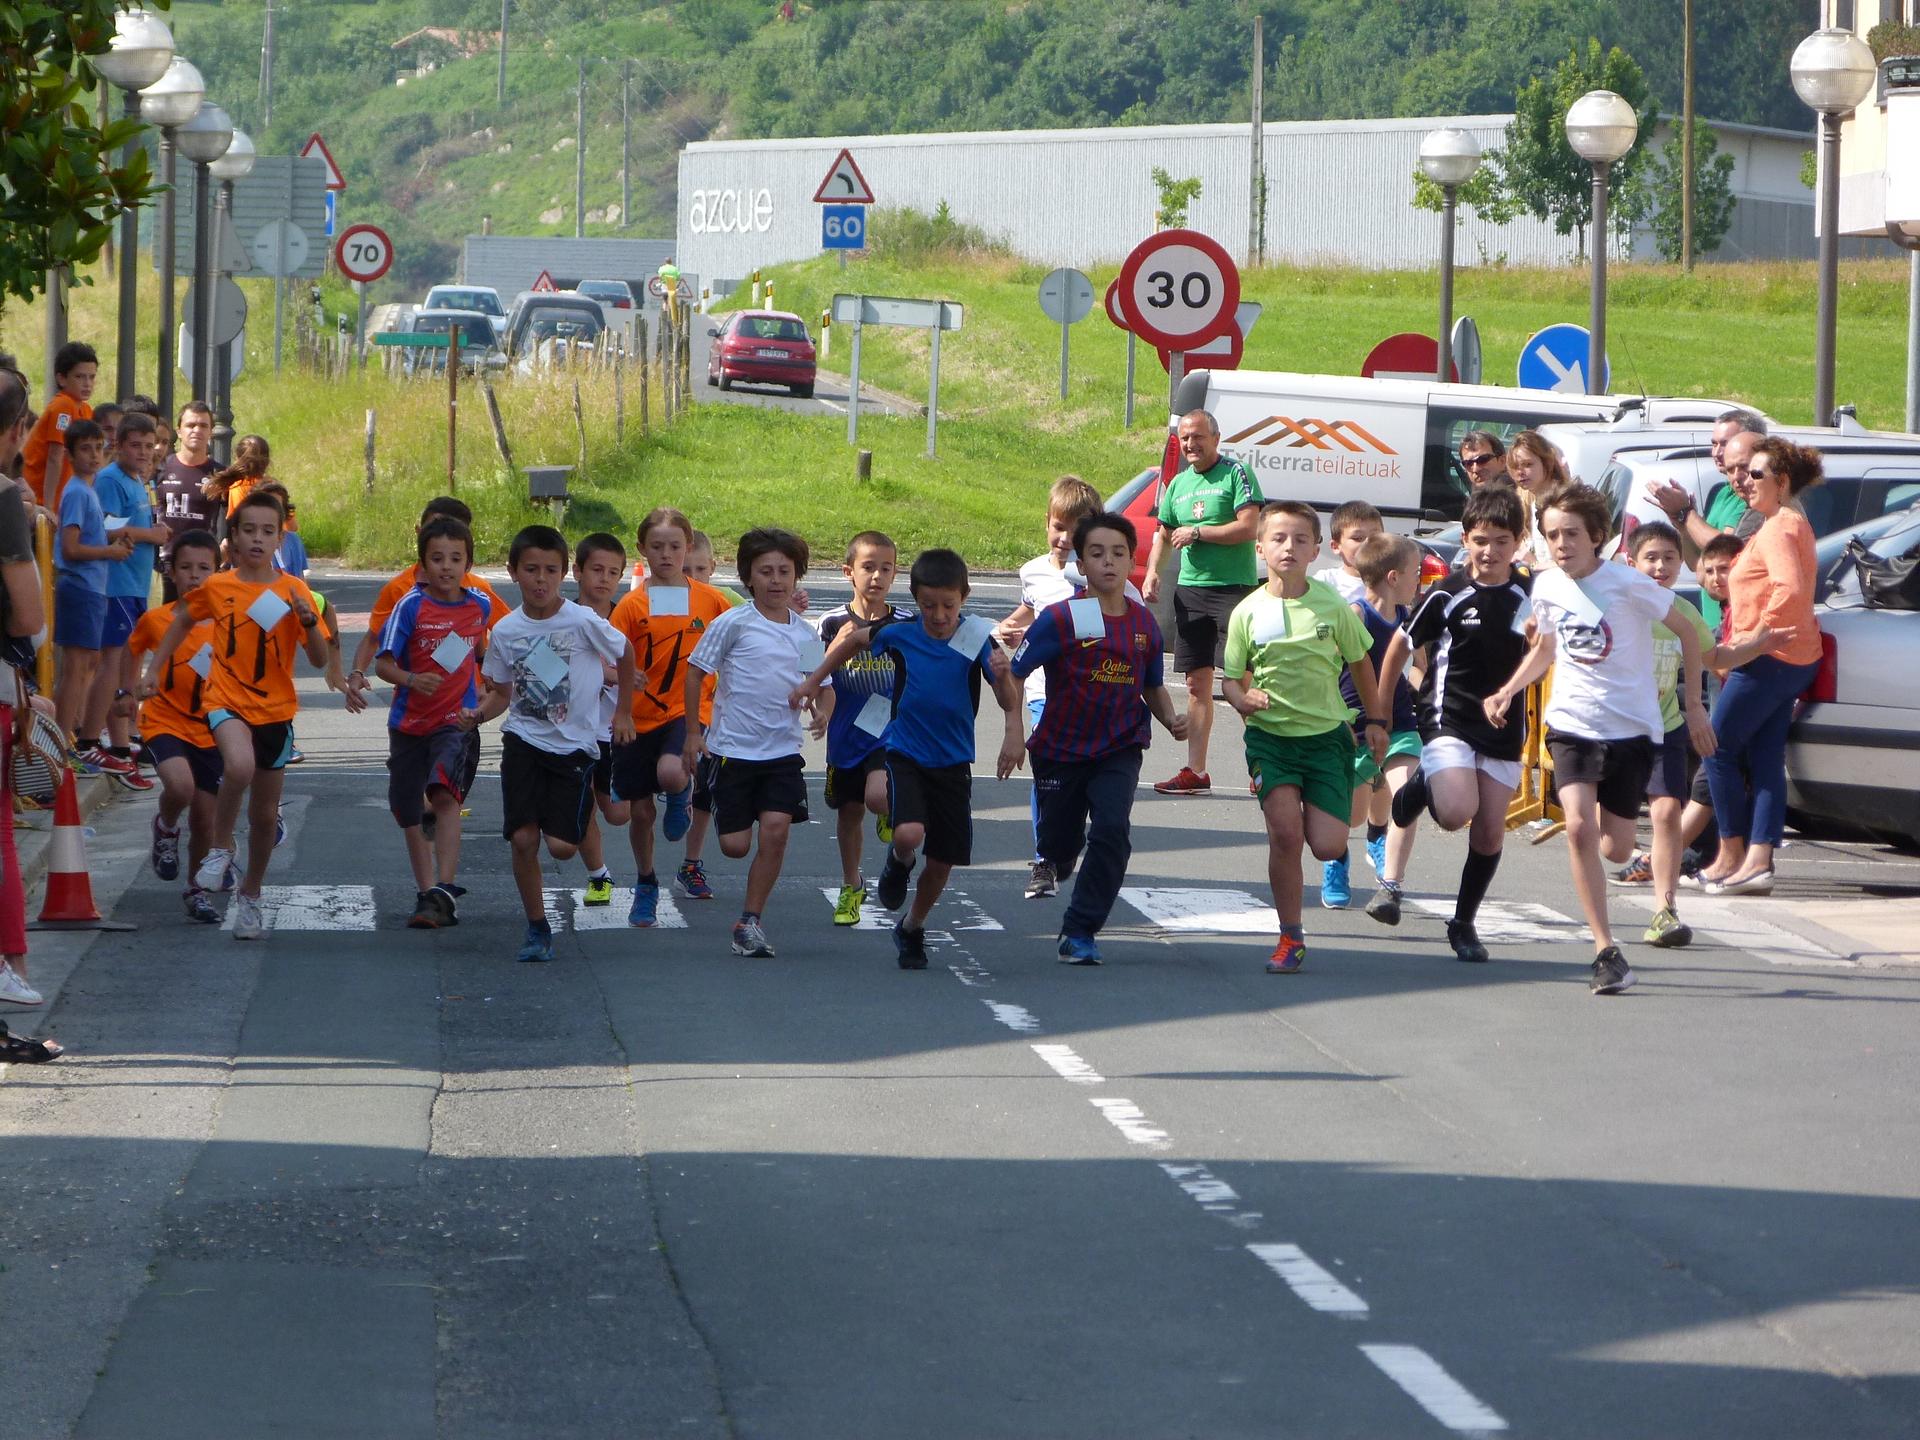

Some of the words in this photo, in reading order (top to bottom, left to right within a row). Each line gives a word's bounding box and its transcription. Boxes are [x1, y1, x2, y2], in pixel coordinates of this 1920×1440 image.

[690, 188, 773, 233] azcue
[825, 216, 861, 238] 60
[350, 244, 379, 263] 70
[1147, 270, 1211, 309] 30
[840, 657, 896, 671] redato
[1102, 658, 1132, 675] Qatar
[1088, 669, 1135, 685] Foundation
